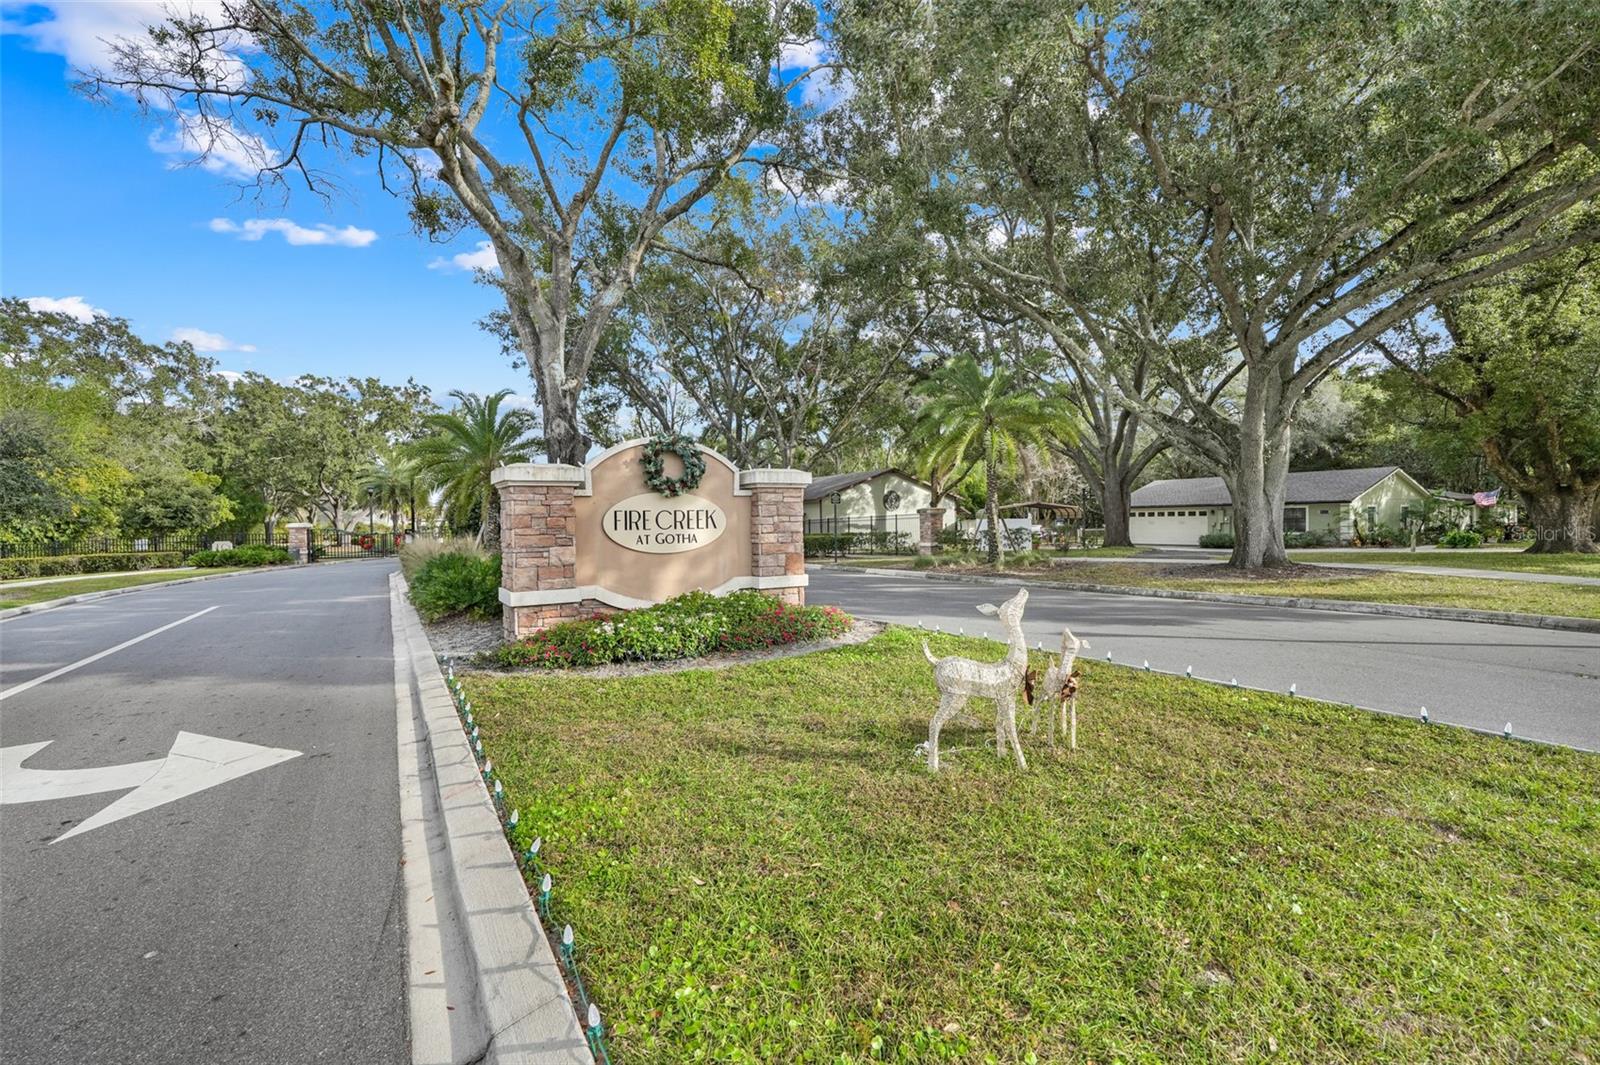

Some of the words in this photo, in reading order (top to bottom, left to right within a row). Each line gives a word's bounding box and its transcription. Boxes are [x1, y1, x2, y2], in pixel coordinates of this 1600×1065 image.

[614, 510, 651, 531] FIRE
[655, 509, 718, 531] CREEK
[636, 534, 651, 545] AT
[655, 532, 698, 545] GOTHA
